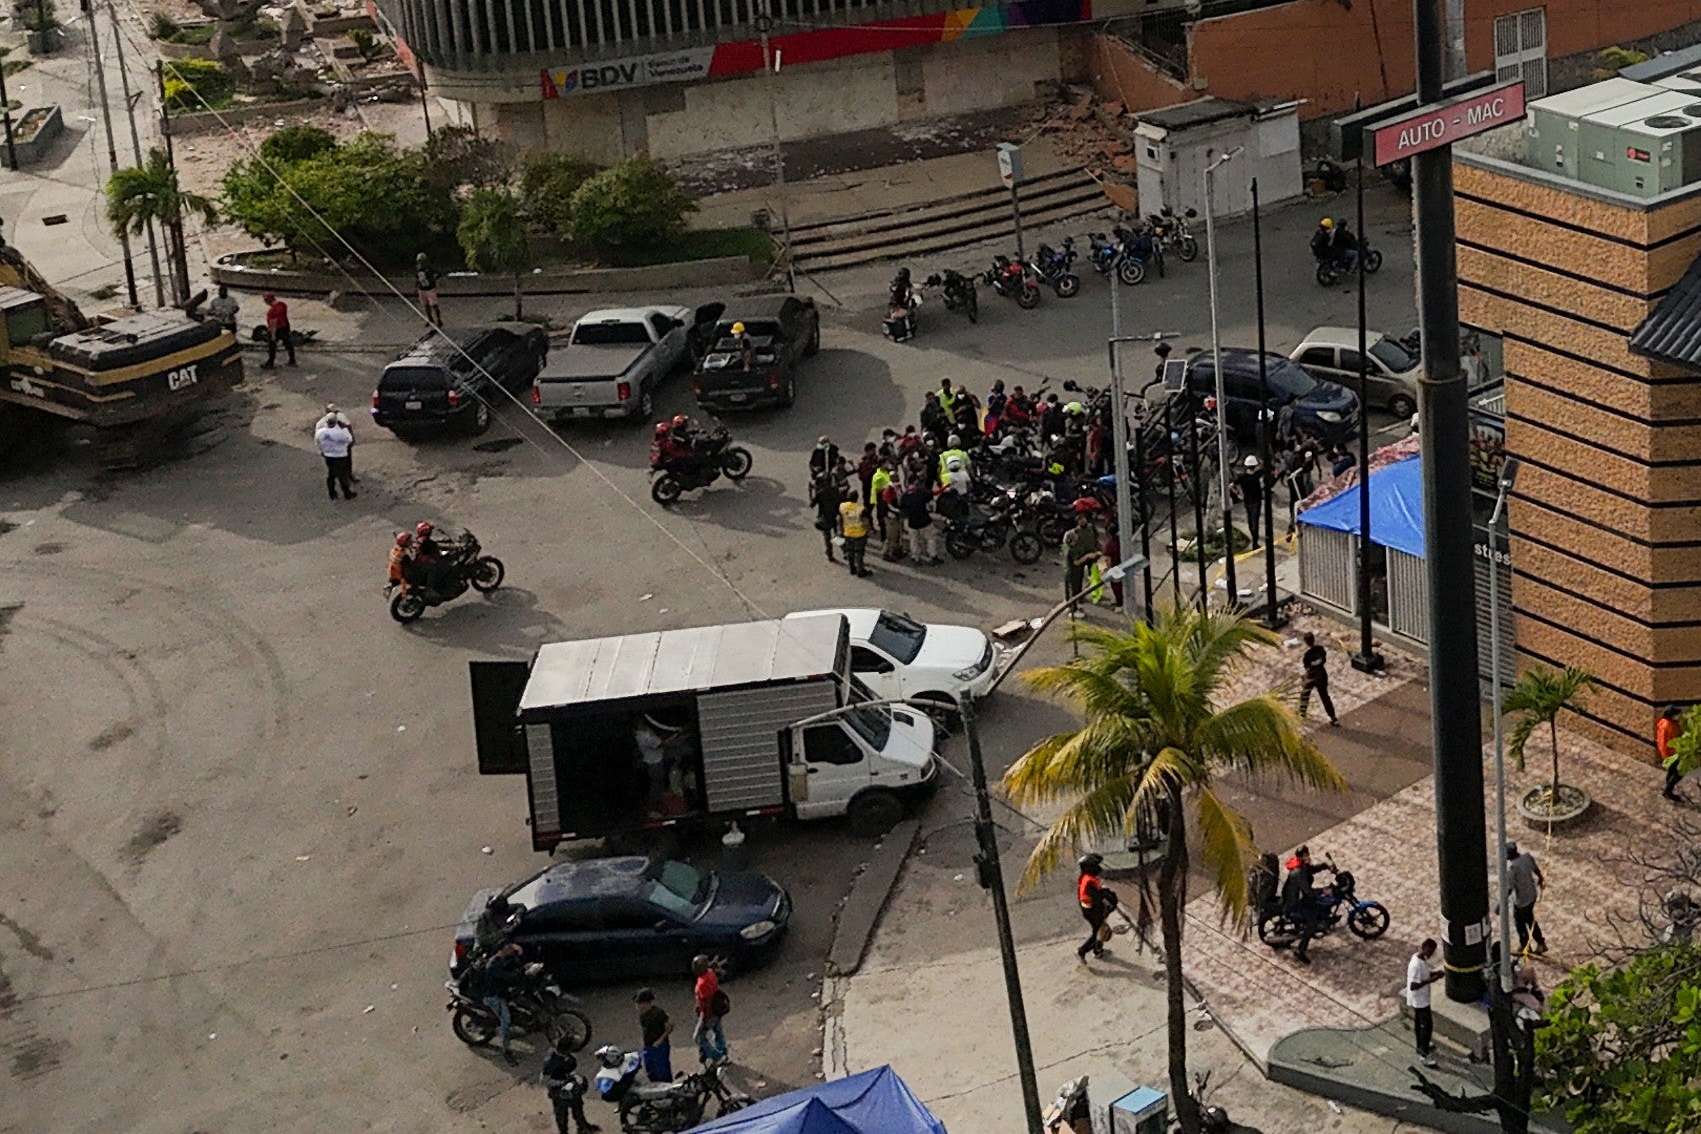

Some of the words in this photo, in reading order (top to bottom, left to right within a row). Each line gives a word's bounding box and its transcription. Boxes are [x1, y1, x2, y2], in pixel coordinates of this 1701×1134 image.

[580, 62, 637, 89] BDV
[1398, 118, 1445, 150] AUTO
[1467, 98, 1504, 125] MAC
[168, 365, 197, 390] CAT
